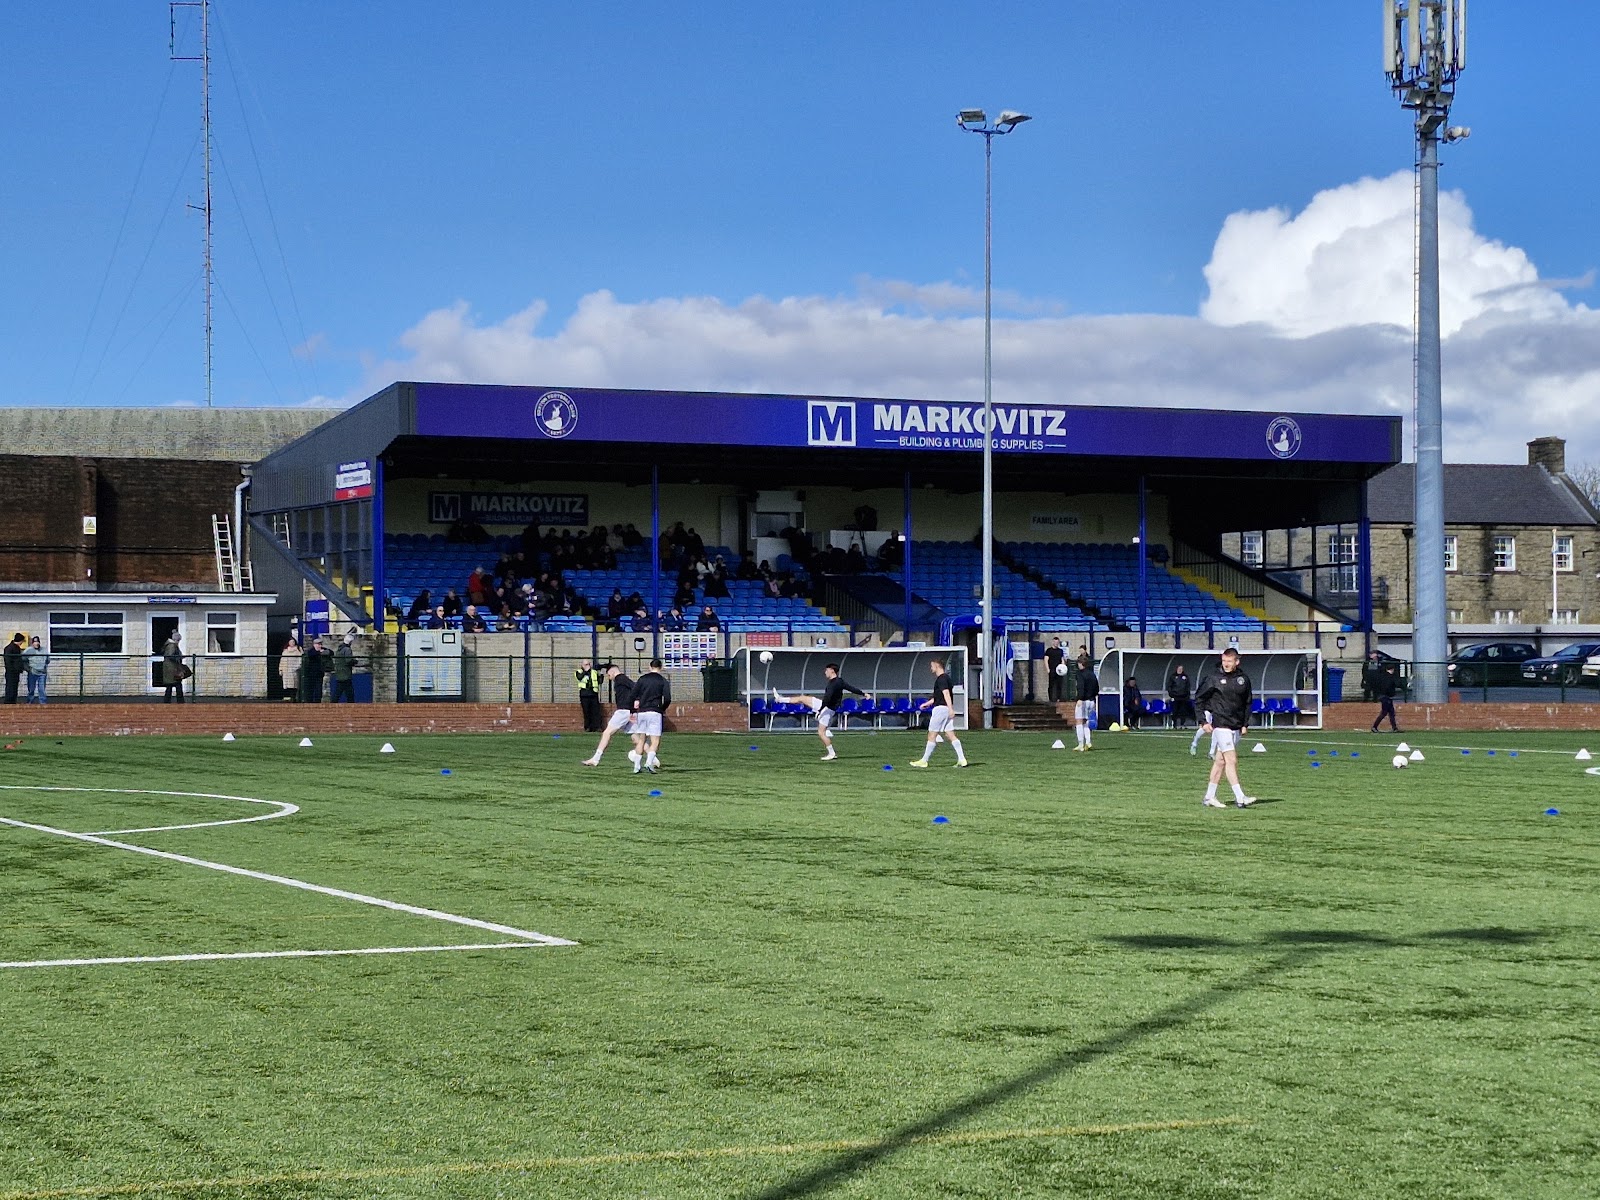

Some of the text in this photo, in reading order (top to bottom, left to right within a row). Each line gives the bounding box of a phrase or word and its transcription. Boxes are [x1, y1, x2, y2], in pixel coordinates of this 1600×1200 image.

[873, 404, 1067, 436] MARKOVITZ
[899, 436, 942, 448] BUILDING
[943, 437, 951, 448] &
[1000, 439, 1044, 450] SUPPLIES
[471, 495, 585, 513] MARKOVITZ
[1032, 516, 1079, 525] FAMILY AREA
